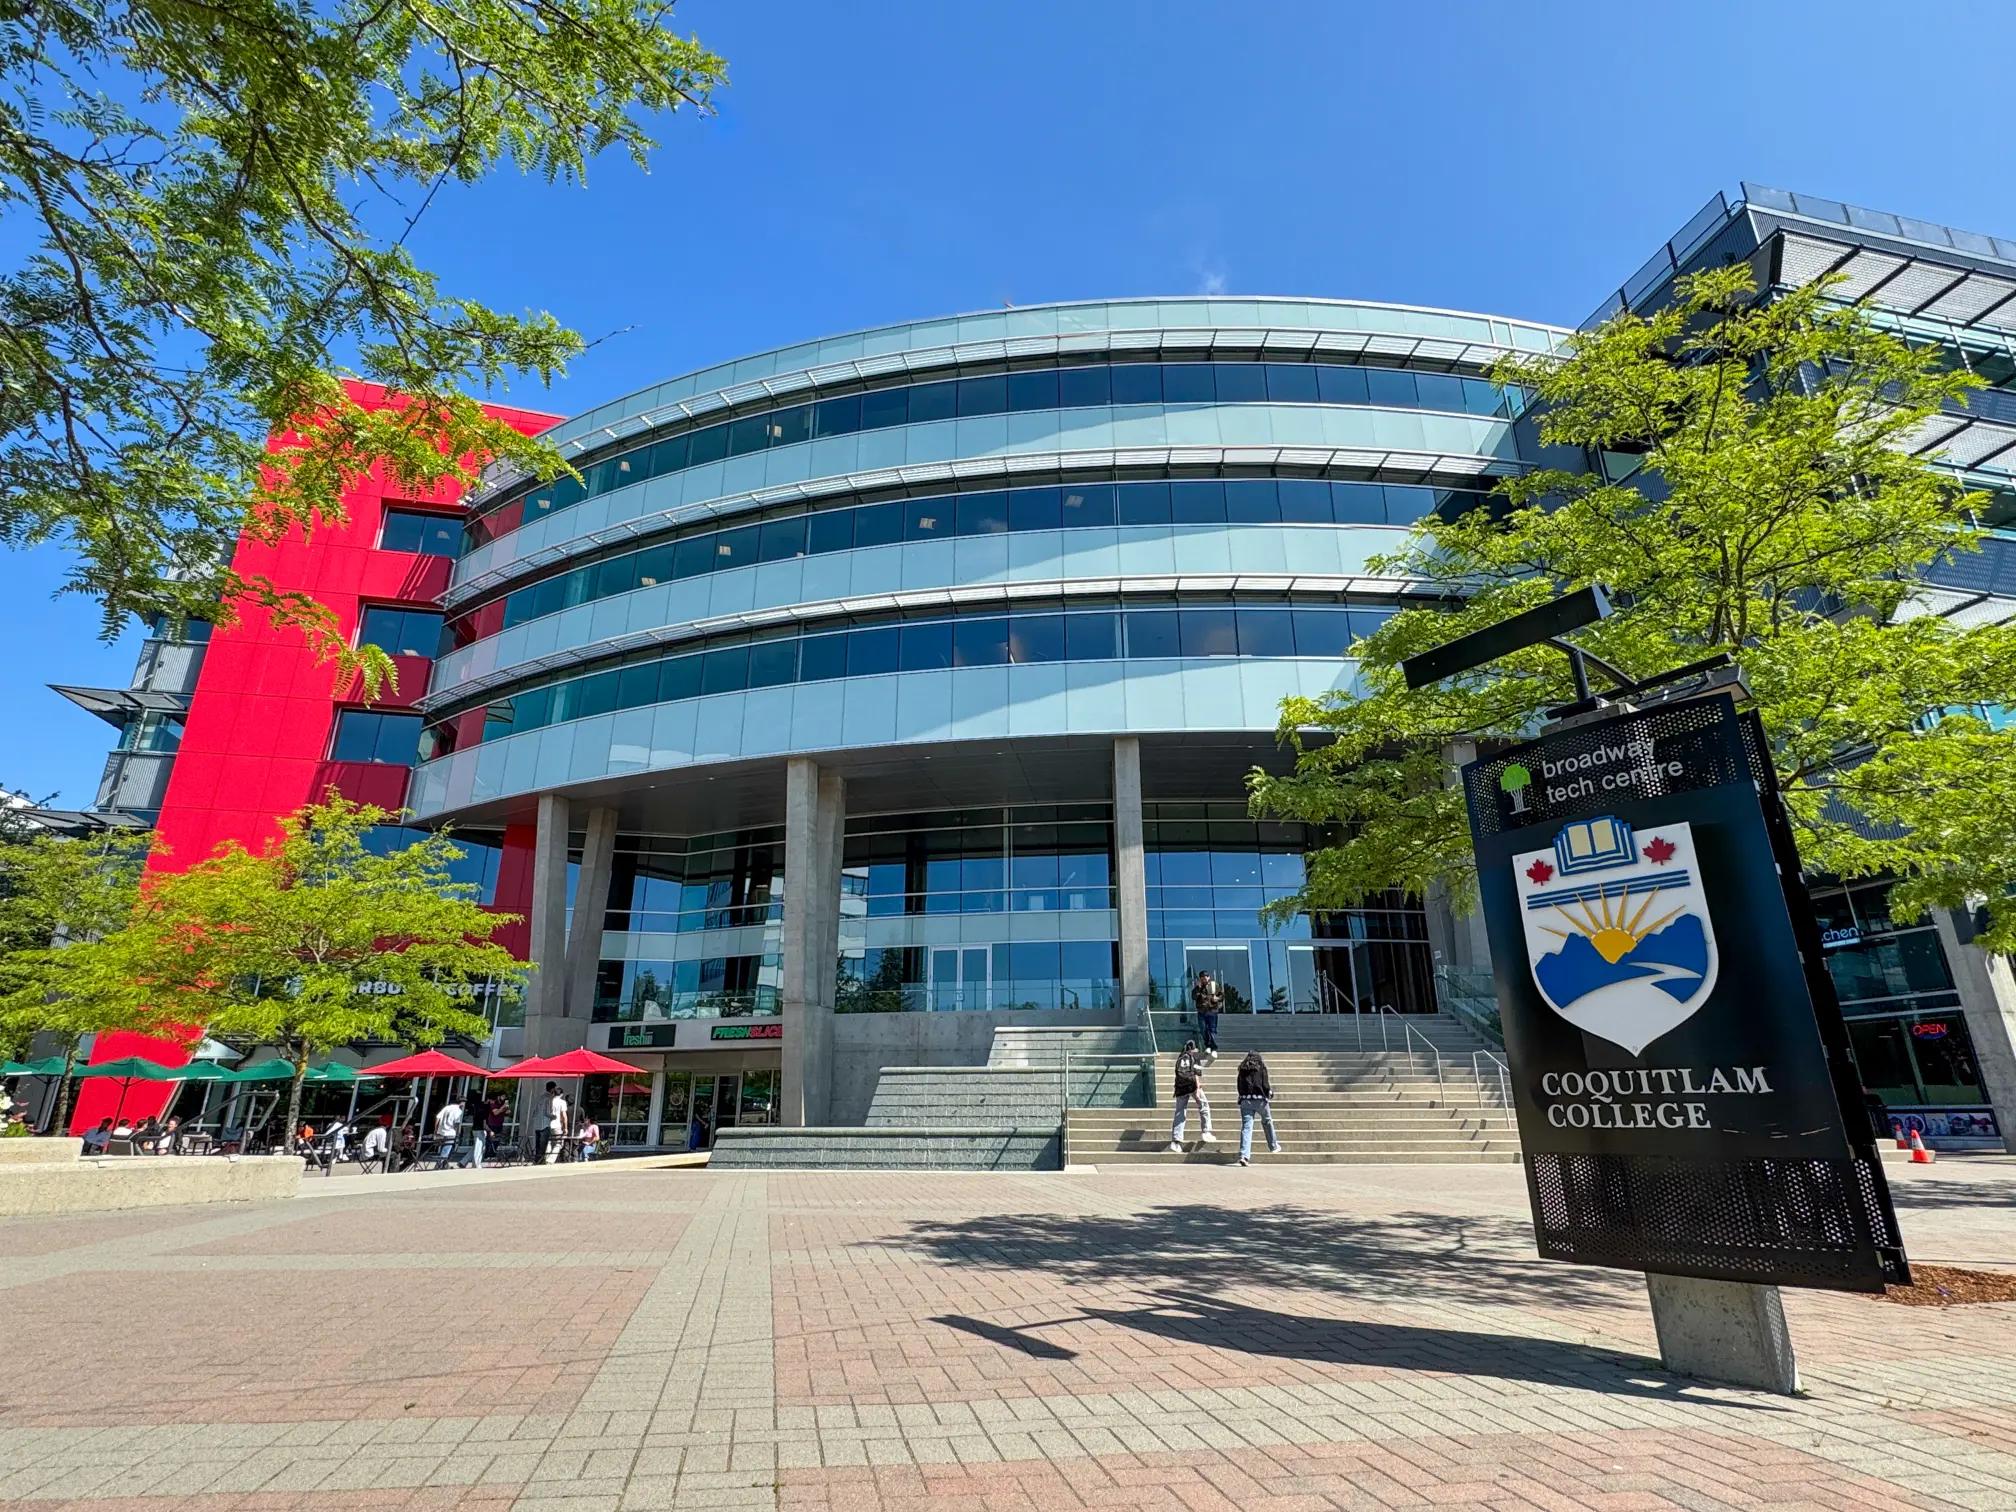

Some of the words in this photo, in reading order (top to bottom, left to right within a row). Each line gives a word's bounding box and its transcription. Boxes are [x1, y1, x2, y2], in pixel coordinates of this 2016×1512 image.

[1542, 737, 1655, 779] broadway
[1546, 776, 1594, 803] tech
[1601, 760, 1684, 790] centre
[1821, 927, 1859, 941] chen
[1913, 1024, 1946, 1036] OPEN
[1542, 1066, 1774, 1103] COQUITLAM
[1547, 1102, 1712, 1129] COLLEGE
